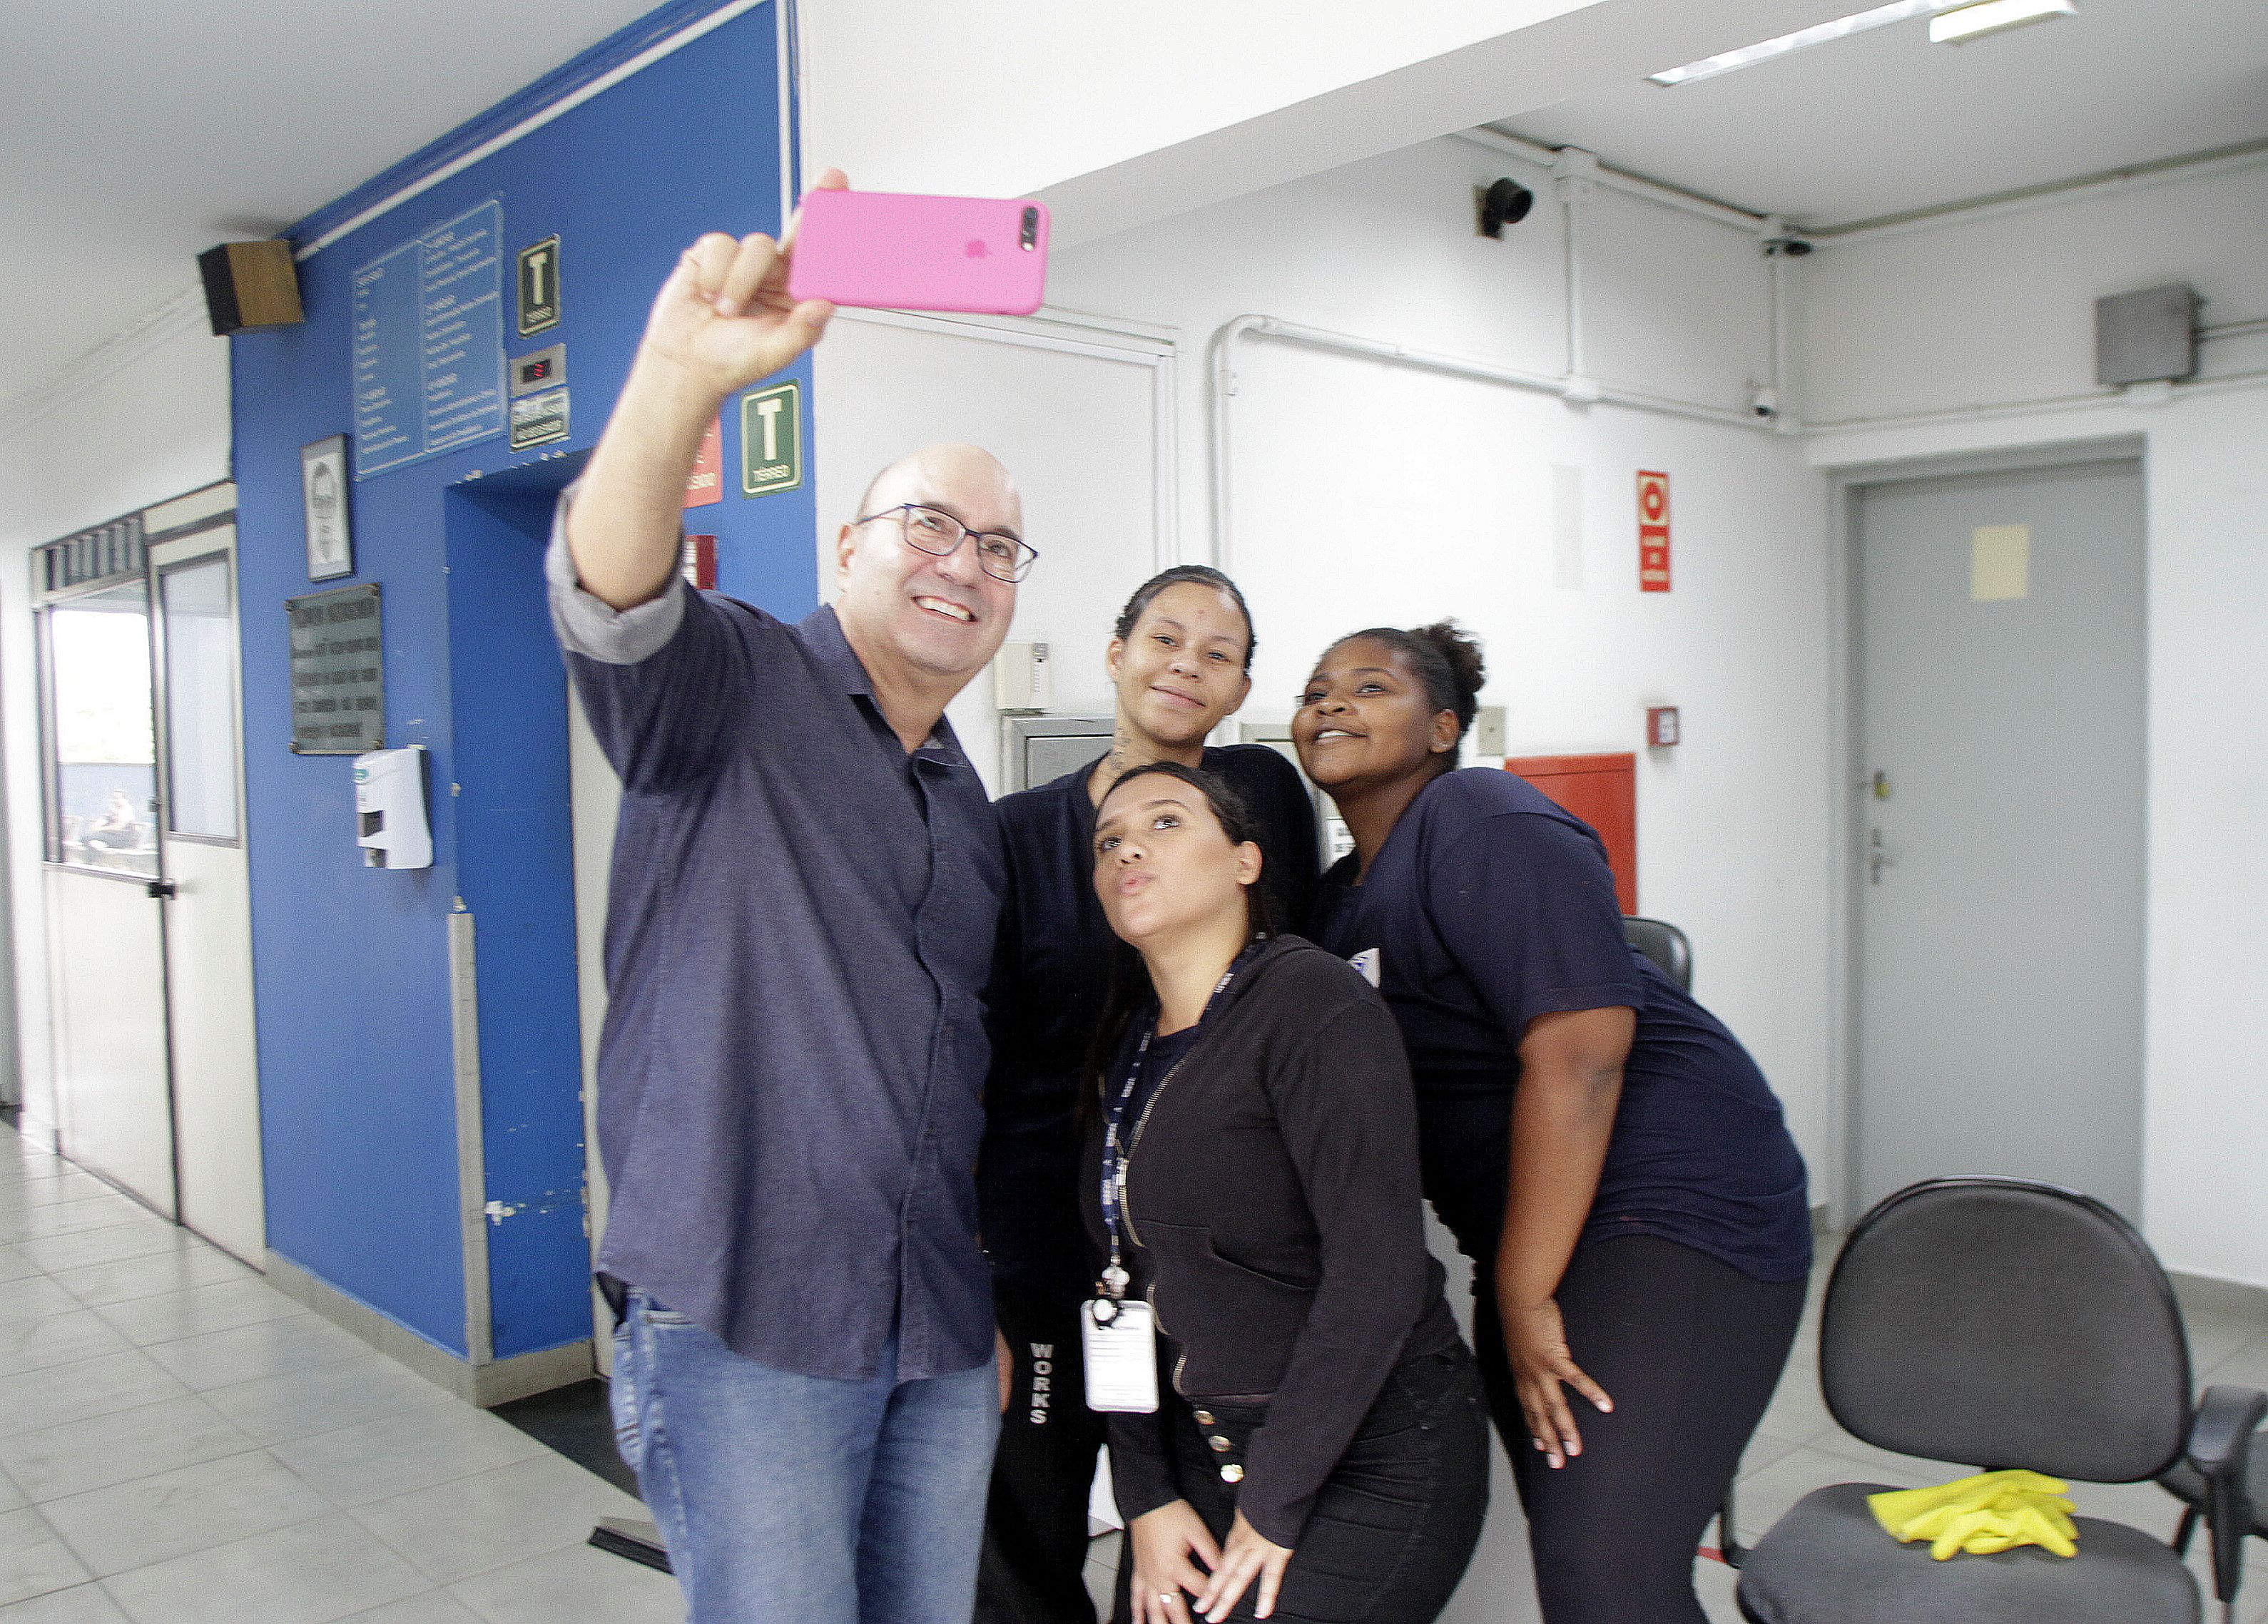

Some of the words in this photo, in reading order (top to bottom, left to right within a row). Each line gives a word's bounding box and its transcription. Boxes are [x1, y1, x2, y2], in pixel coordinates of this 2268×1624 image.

[528, 251, 548, 305] T
[757, 398, 783, 461] T
[1029, 1342, 1054, 1424] WORKS
